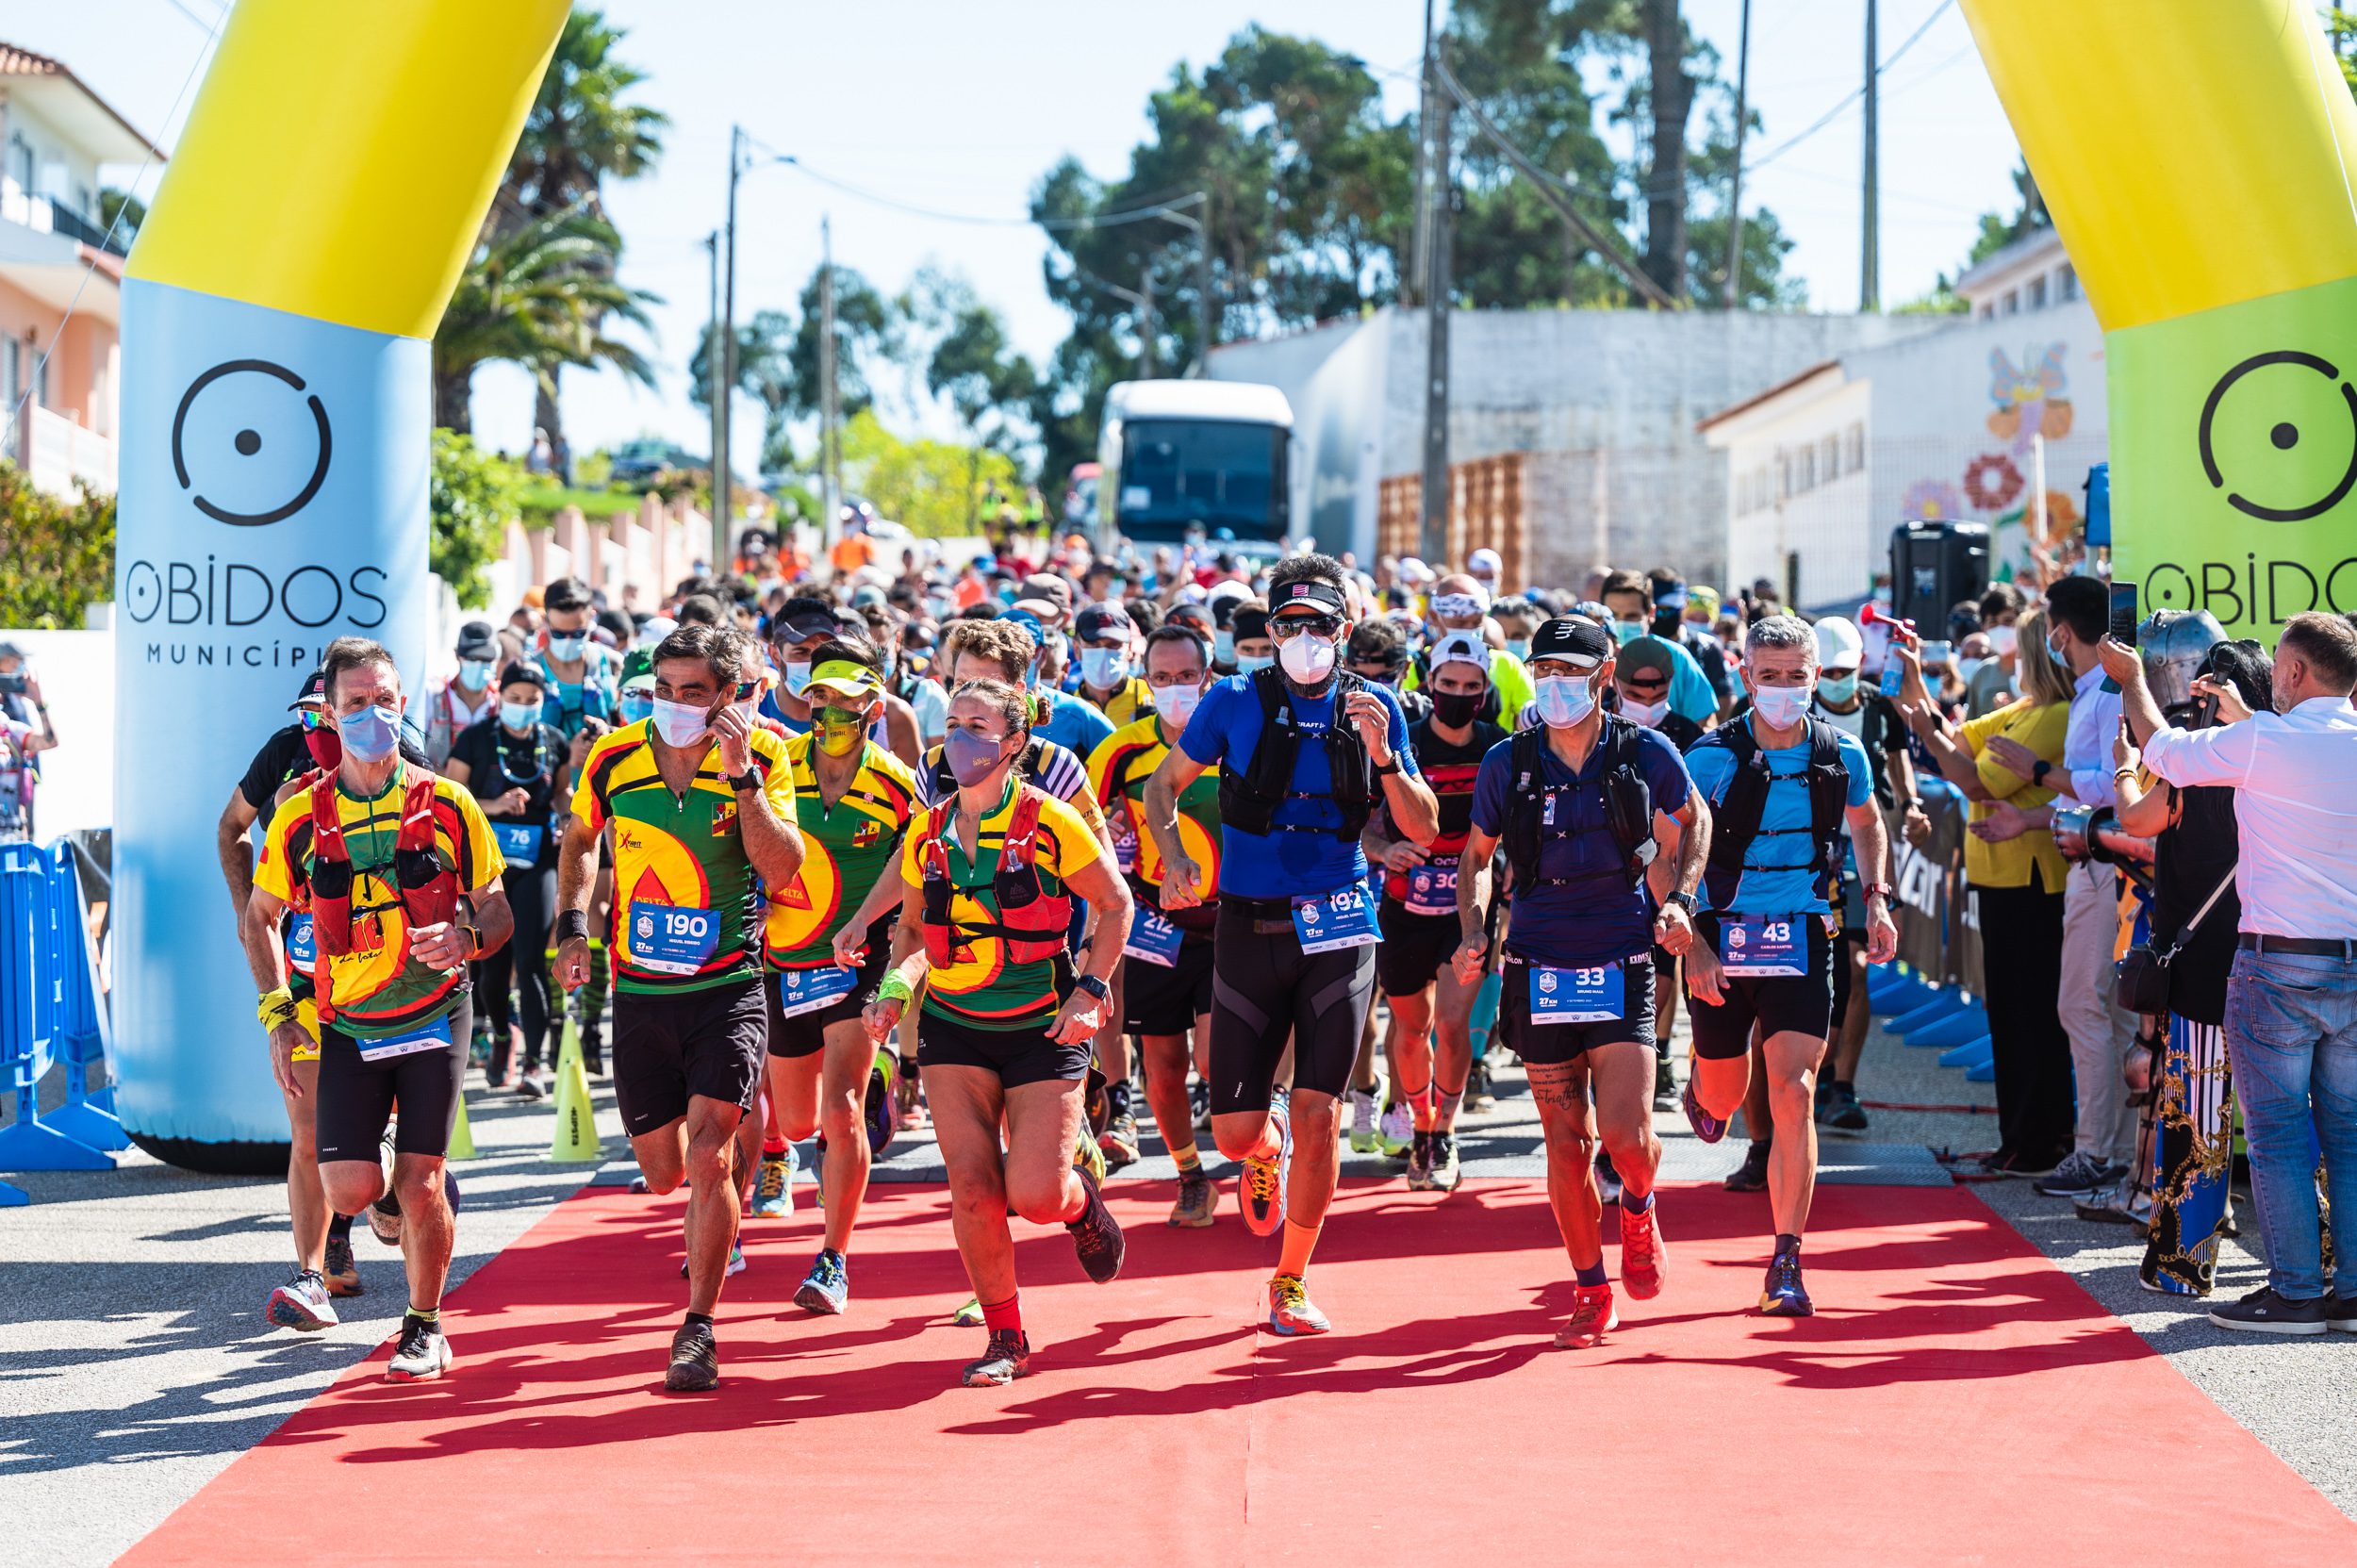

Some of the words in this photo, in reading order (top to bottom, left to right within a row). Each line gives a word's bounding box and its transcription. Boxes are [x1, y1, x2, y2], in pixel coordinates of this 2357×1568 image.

[147, 640, 322, 668] MUNICÍPI
[510, 830, 531, 845] 76
[1330, 891, 1365, 912] 192
[666, 914, 708, 938] 190
[1306, 928, 1315, 936] 27
[1762, 922, 1790, 942] 43
[294, 947, 303, 955] 27
[1575, 966, 1606, 986] 33
[571, 1108, 580, 1146] KIPSTA
